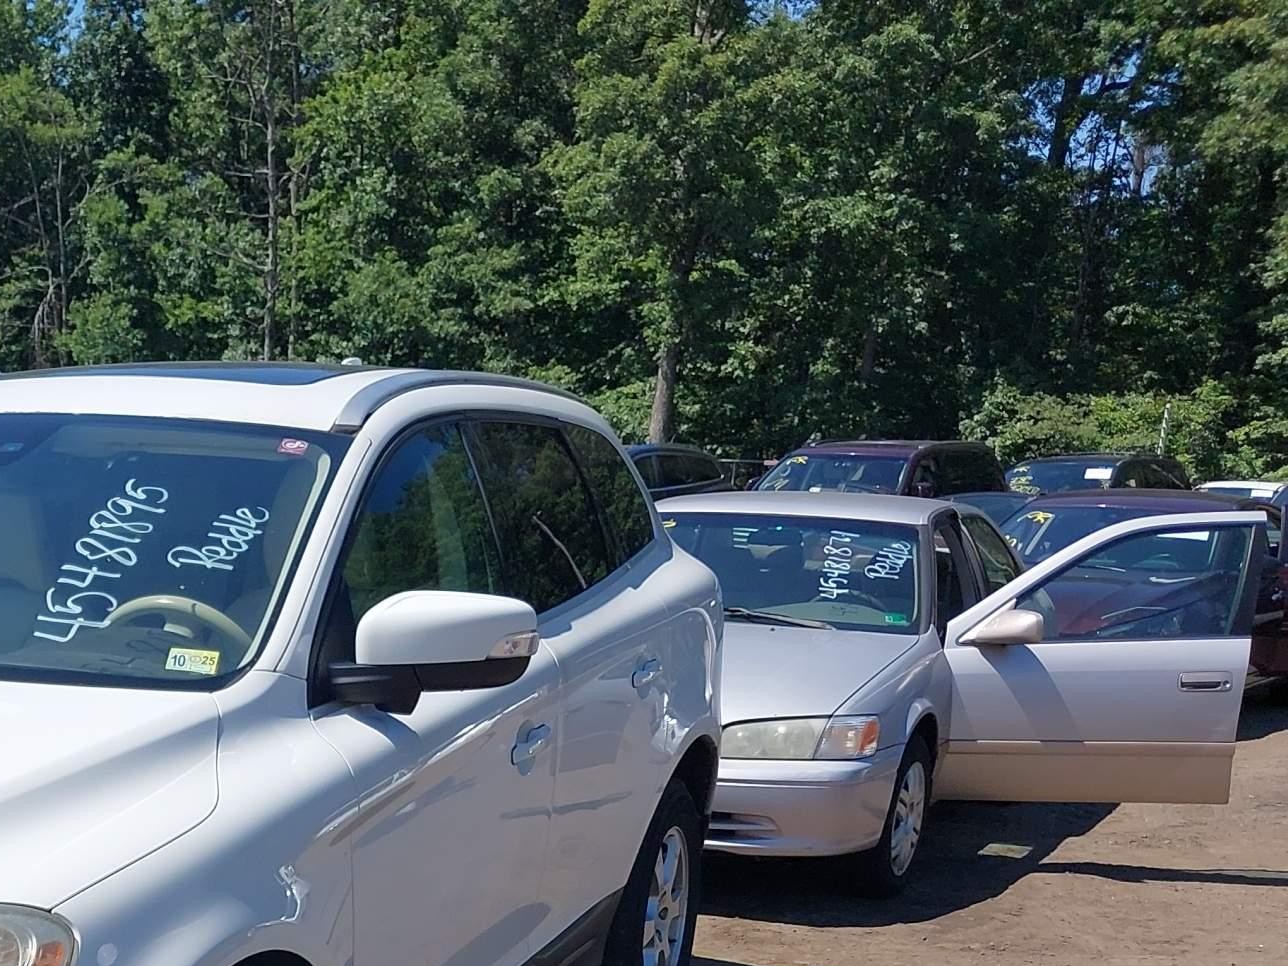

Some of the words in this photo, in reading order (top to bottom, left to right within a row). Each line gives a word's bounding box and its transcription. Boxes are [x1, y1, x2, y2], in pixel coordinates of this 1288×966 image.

[32, 478, 170, 643] 45481895
[171, 654, 186, 667] 10
[200, 655, 216, 666] 25
